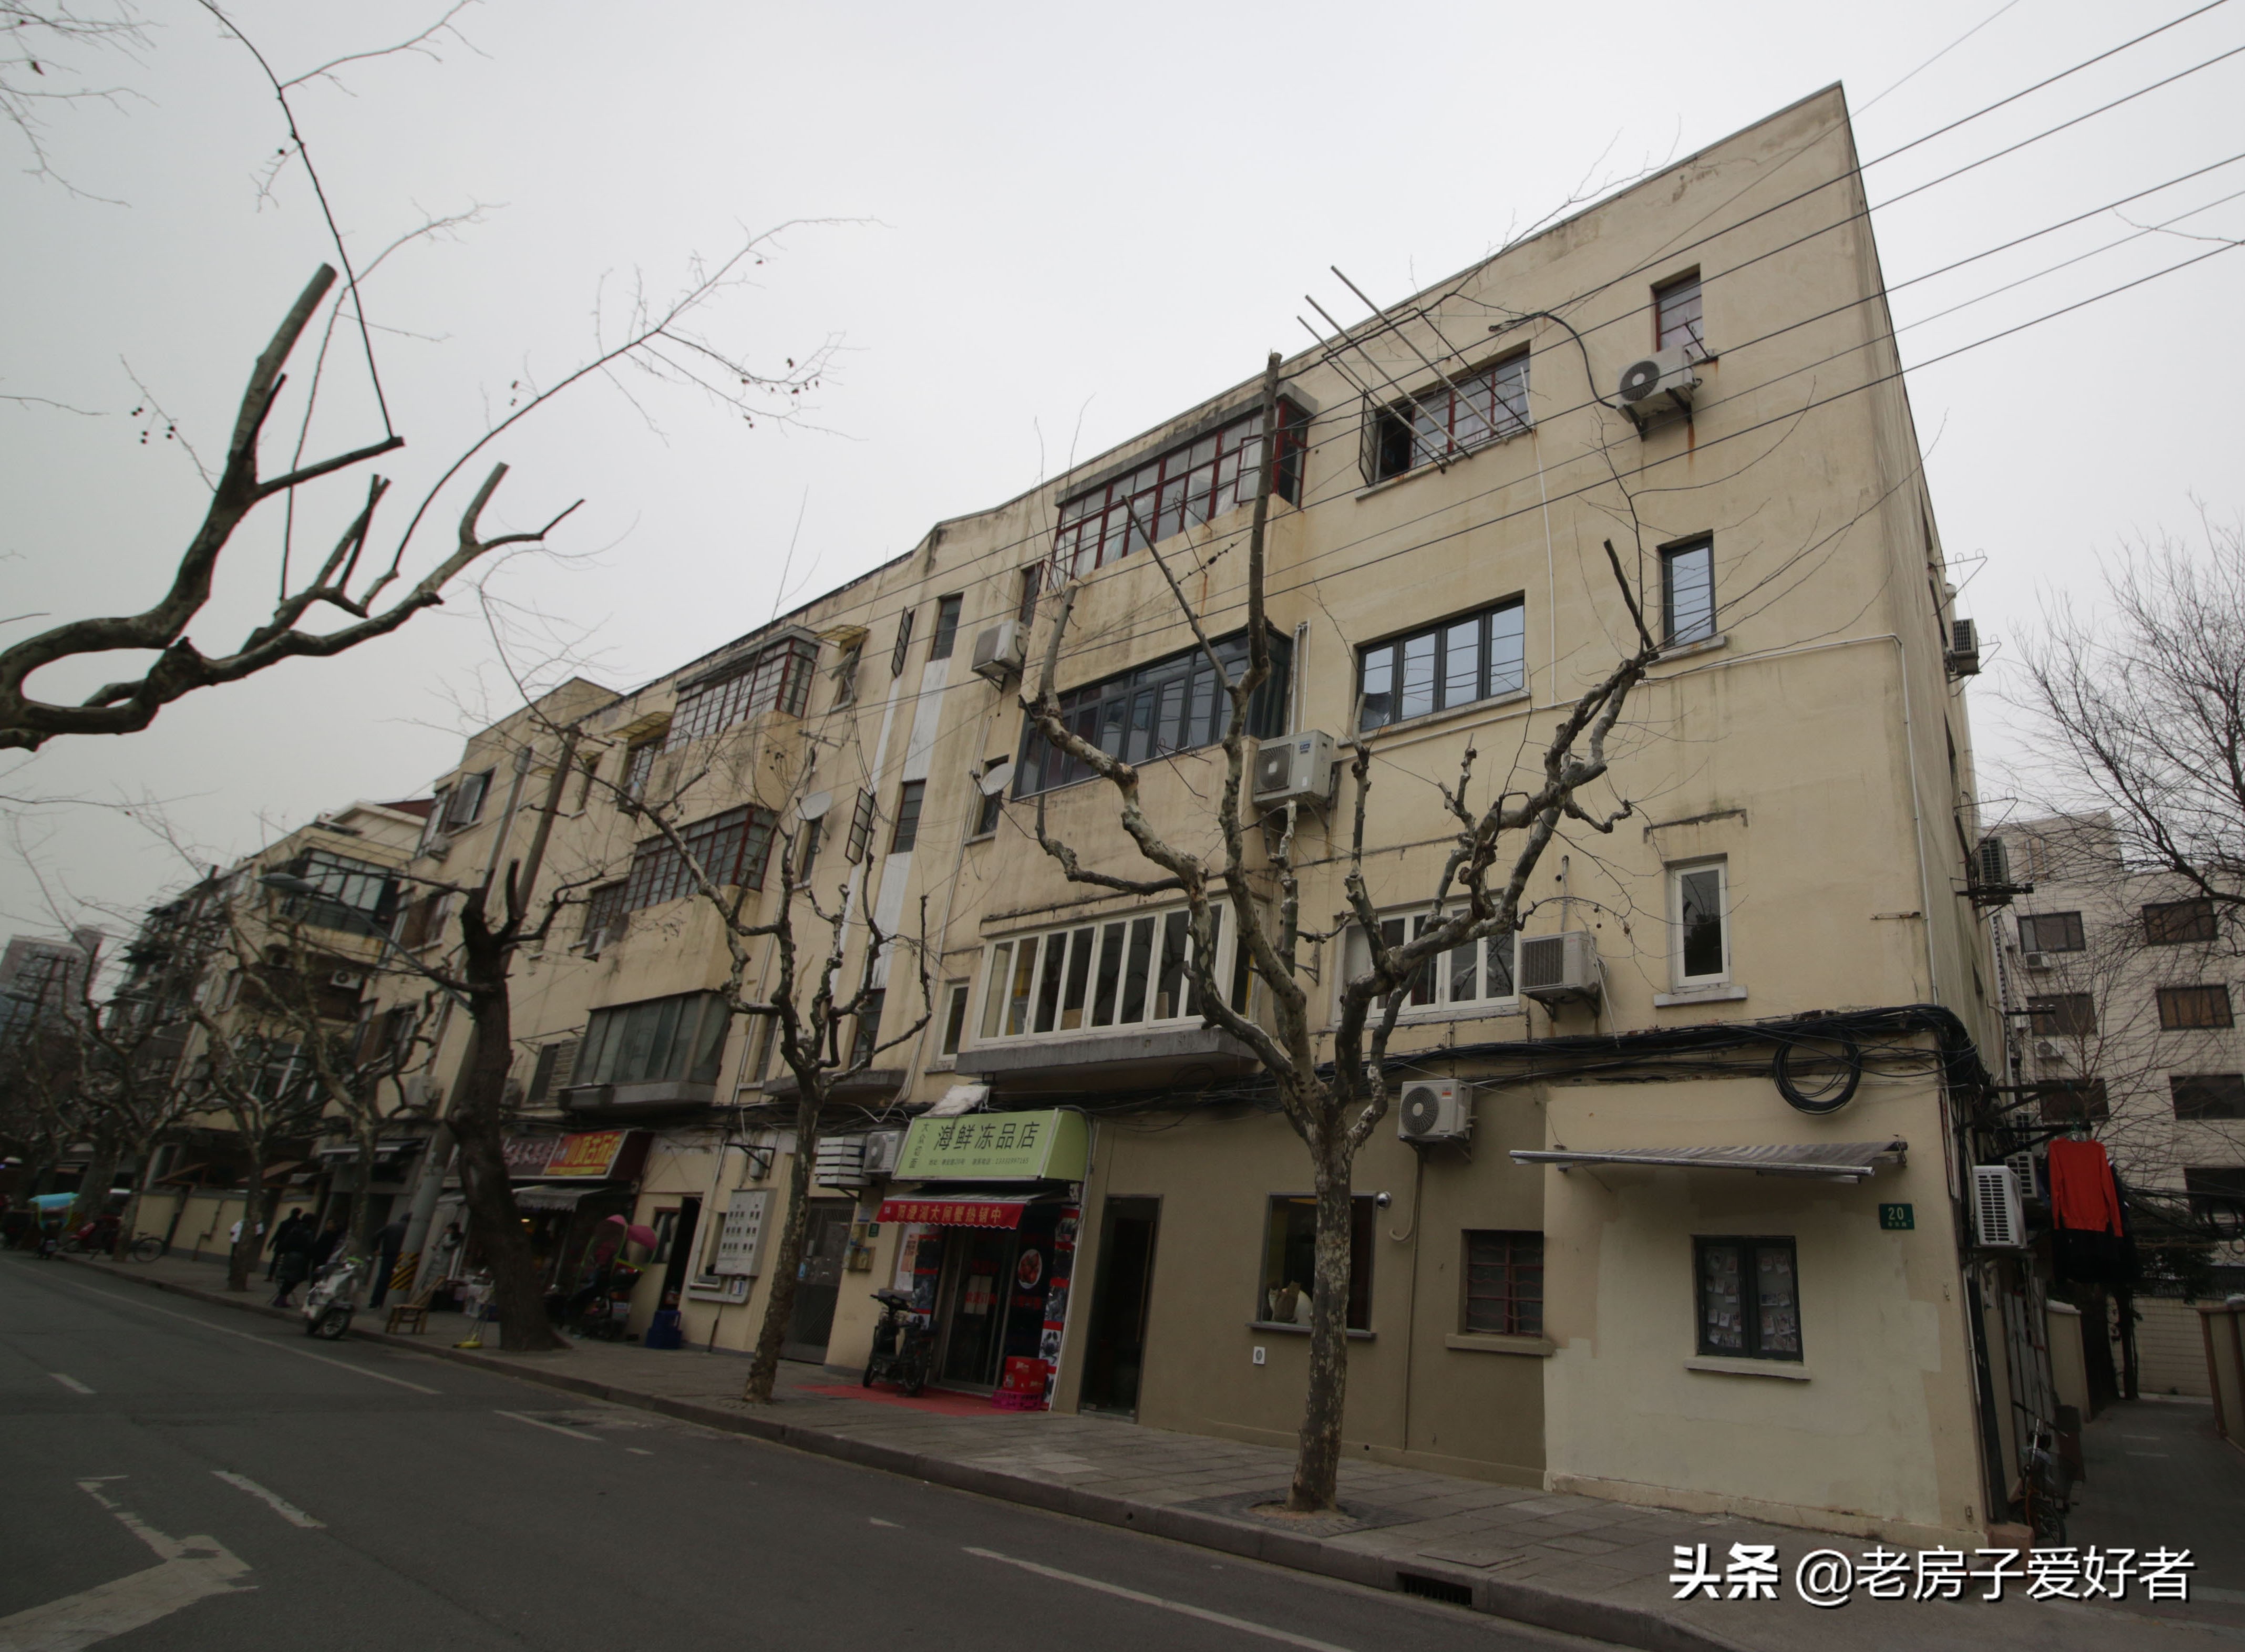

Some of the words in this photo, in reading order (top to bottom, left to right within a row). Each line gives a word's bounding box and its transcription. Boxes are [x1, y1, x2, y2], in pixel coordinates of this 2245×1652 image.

[933, 1121, 1041, 1151] 海鲜冻品店
[897, 1204, 1002, 1223] 阳澄湖大闸蟹热销中
[1888, 1206, 1904, 1220] 20
